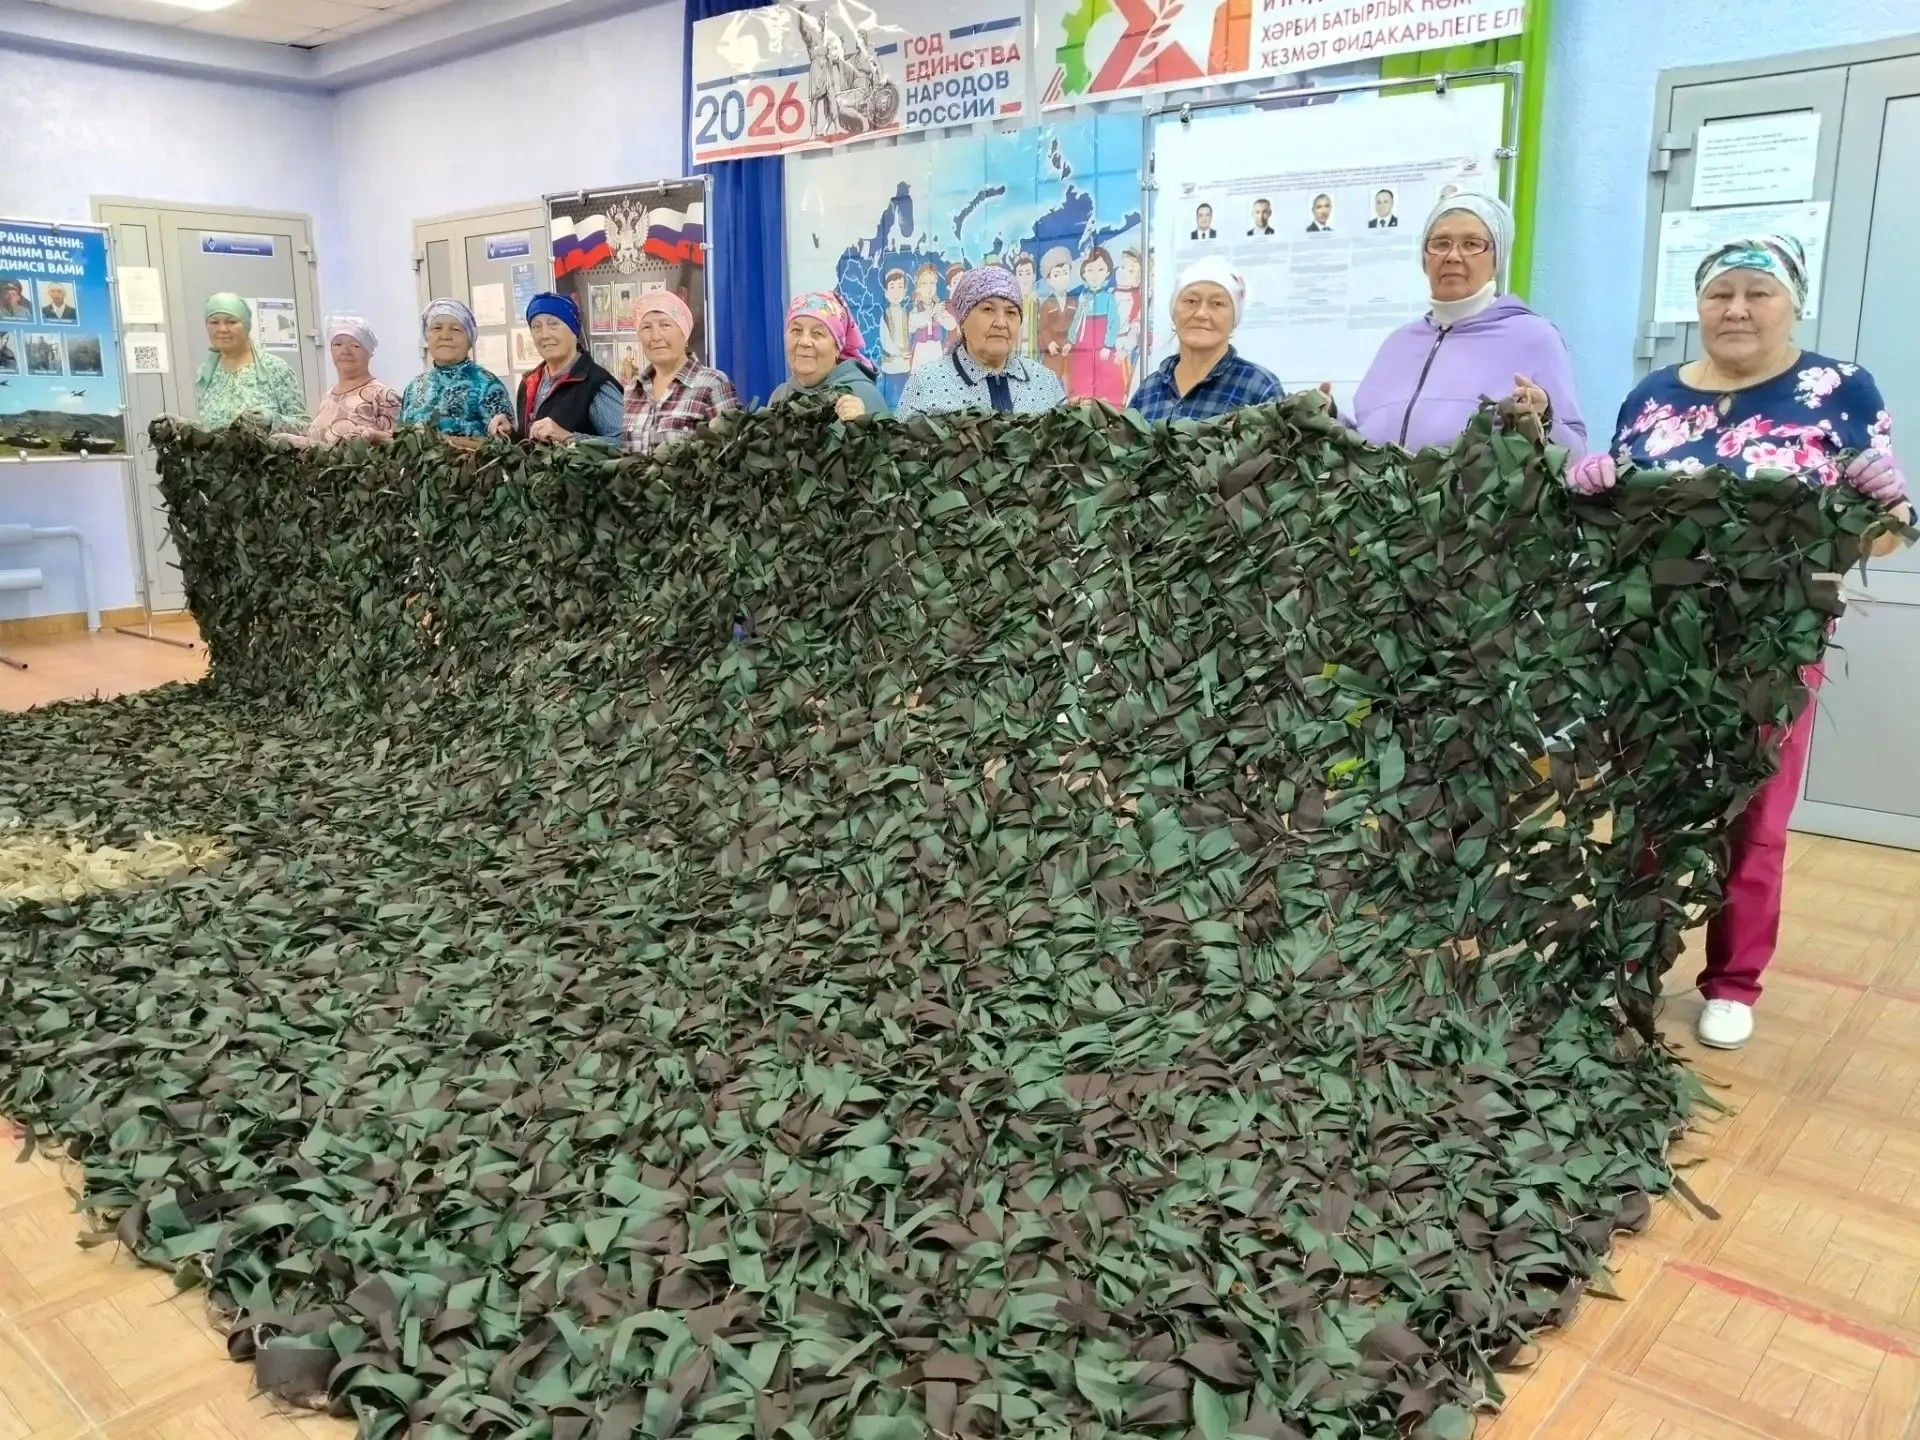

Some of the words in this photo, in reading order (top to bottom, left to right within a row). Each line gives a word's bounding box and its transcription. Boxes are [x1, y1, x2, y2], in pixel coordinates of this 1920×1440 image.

[1262, 17, 1316, 42] ХӘРБИ
[1322, 0, 1414, 31] БАТЫРЛЫК
[904, 33, 943, 58] ГОД
[1261, 40, 1328, 69] ХЕЗМӘТ
[1332, 13, 1488, 54] ФИДАКАРЬЛЕГЕ
[906, 43, 1020, 83] ЕДИНСТВА
[906, 70, 1009, 105] НАРОДОВ
[696, 81, 805, 145] 2026
[906, 97, 995, 128] РОССИИ
[0, 245, 43, 259] МНИМ
[45, 249, 74, 263] ВАС,
[38, 235, 84, 249] ЧЕЧНИ:
[47, 263, 85, 276] ВАМИ
